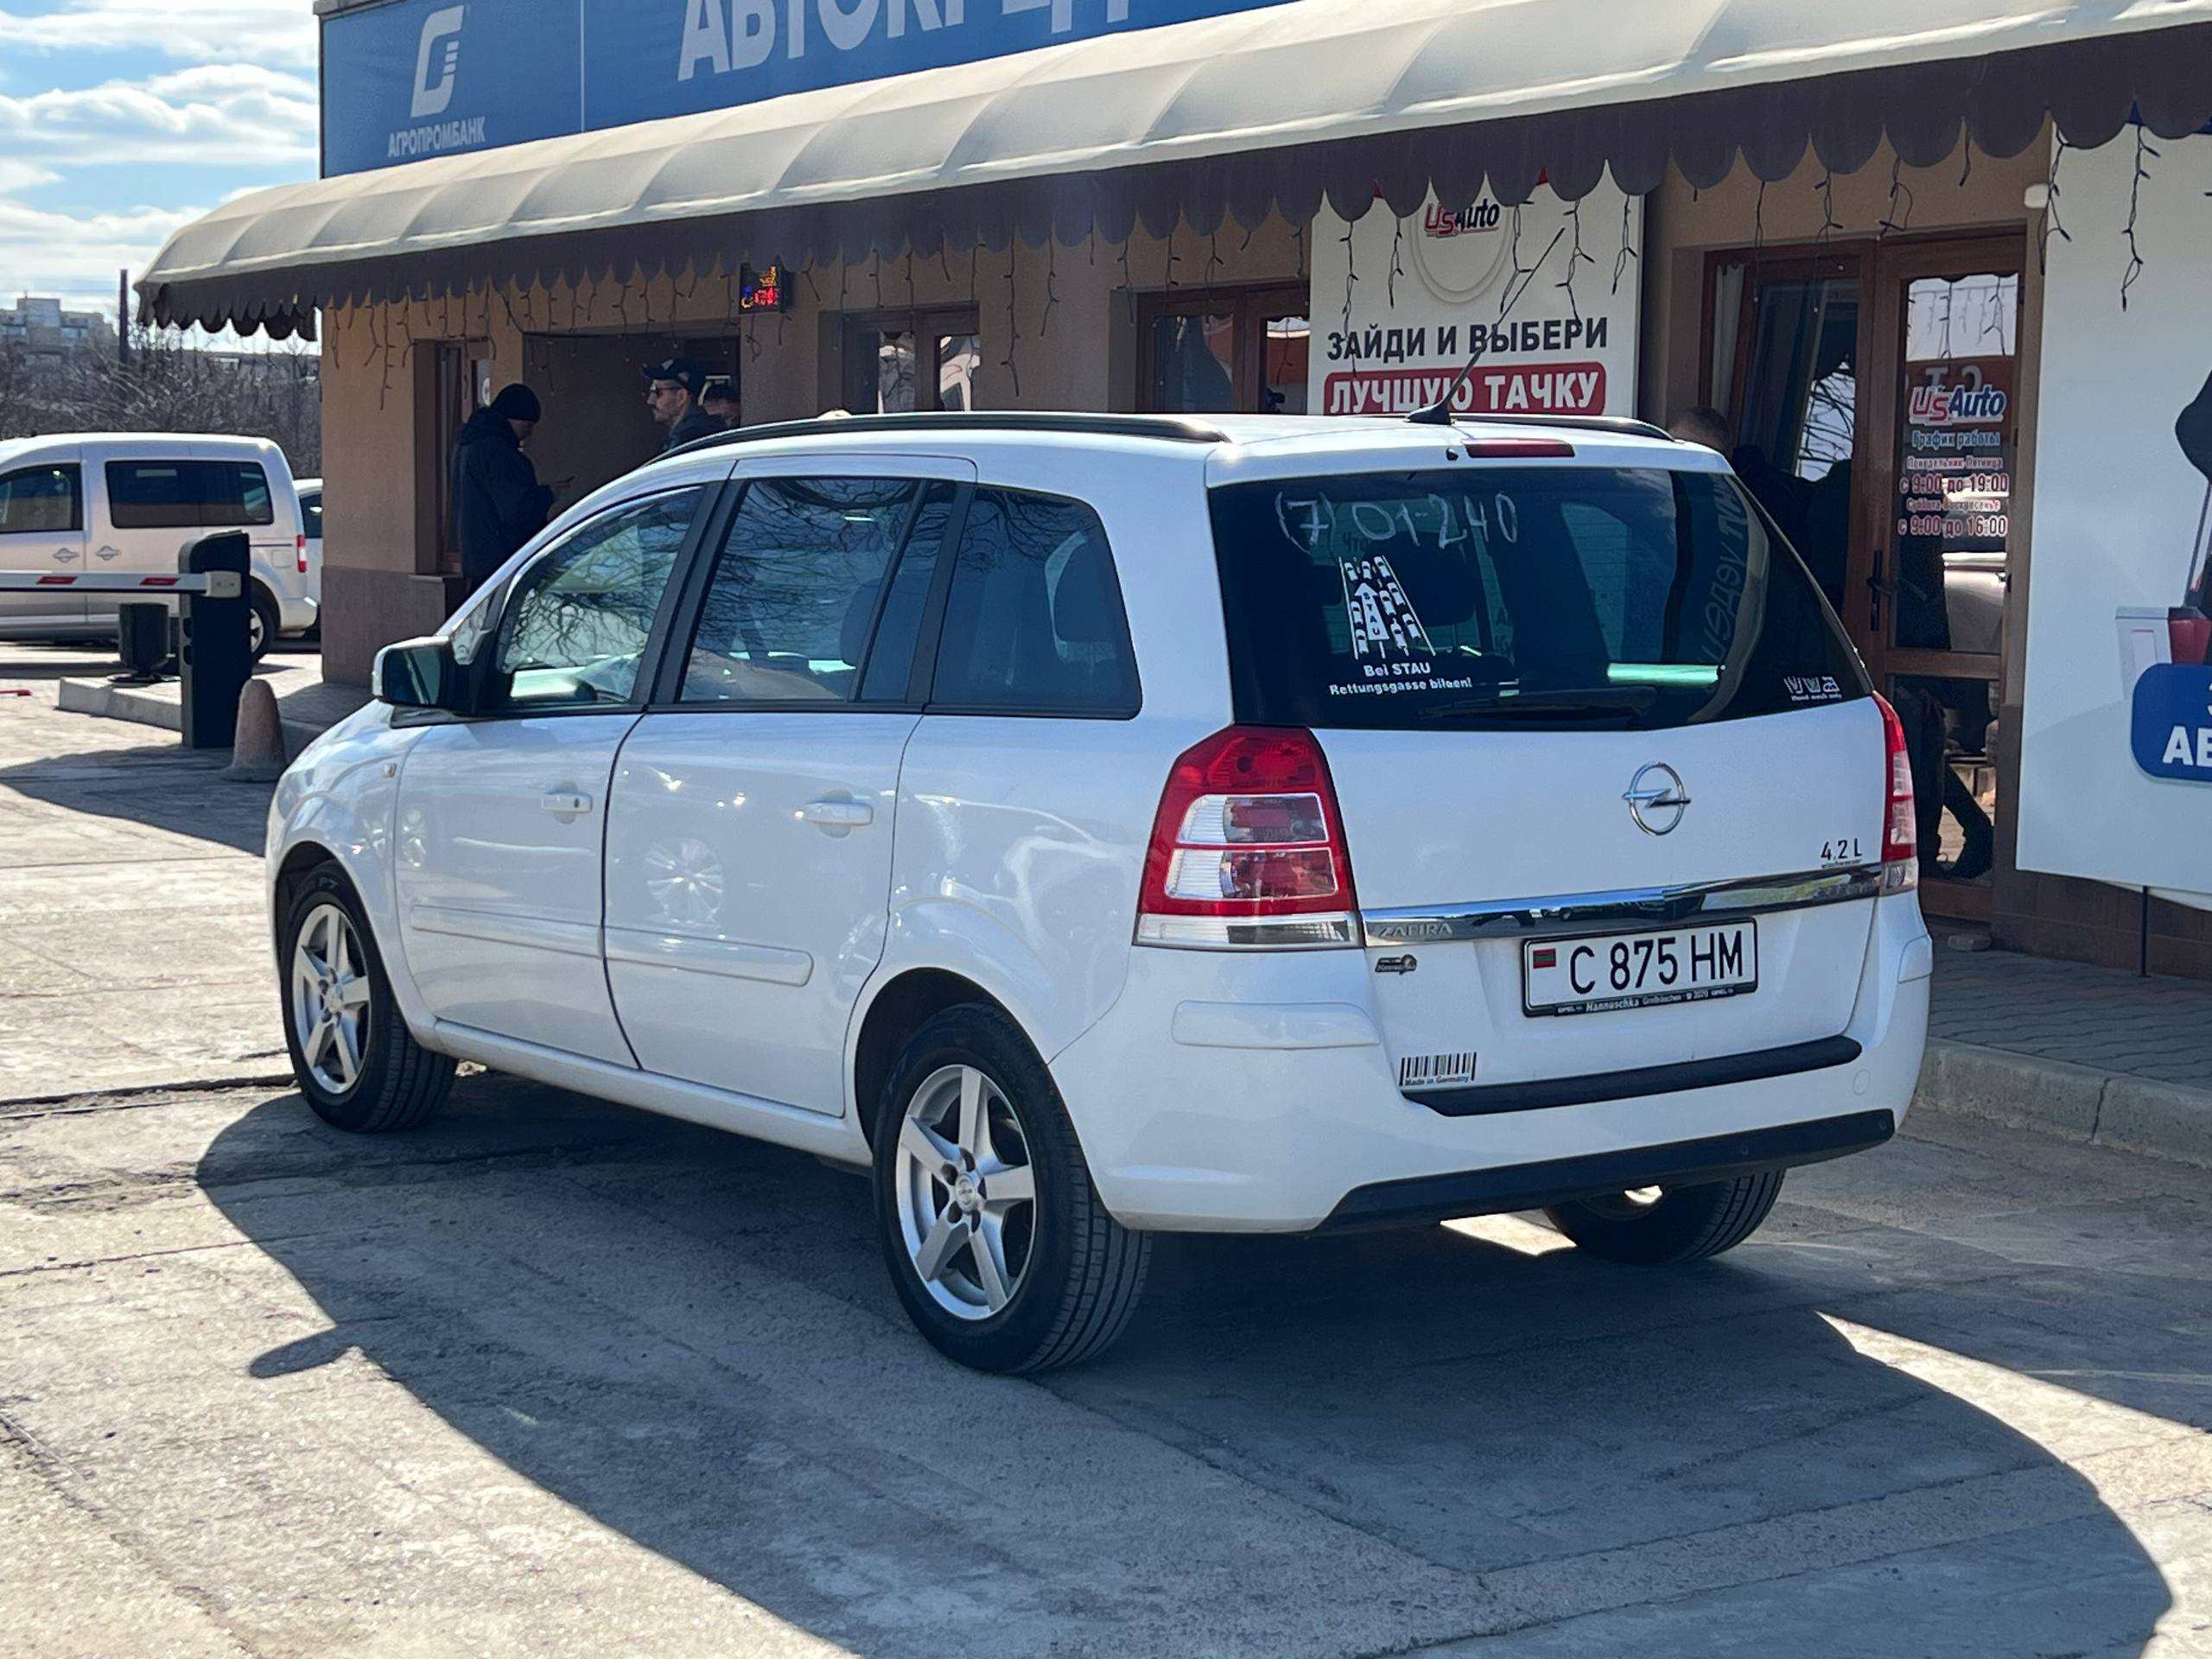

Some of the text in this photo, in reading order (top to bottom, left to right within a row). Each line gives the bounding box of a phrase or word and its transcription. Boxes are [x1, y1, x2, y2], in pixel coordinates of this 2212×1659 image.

[387, 116, 486, 158] АГРОПРОМБАНК
[1326, 317, 1608, 363] ЗАЙДИ И ВЫБЕРИ
[1330, 372, 1599, 414] ЛУЧШУЮ ТАЧКУ
[1910, 385, 2006, 422] USAuto
[1957, 429, 2001, 449] работы
[1911, 474, 1943, 493] 9:00
[1947, 478, 1964, 493] до
[1970, 474, 2009, 493] 19:00
[1910, 516, 1942, 534] 9:00
[1945, 519, 1963, 537] до
[1968, 516, 2008, 535] 16:00
[1363, 662, 1431, 677] Bei STAU
[1329, 681, 1427, 696] Rettungsgasse
[1821, 837, 1863, 861] 4.2 L
[1379, 923, 1452, 937] ZAFIRA
[1570, 931, 1743, 995] C 875 HM
